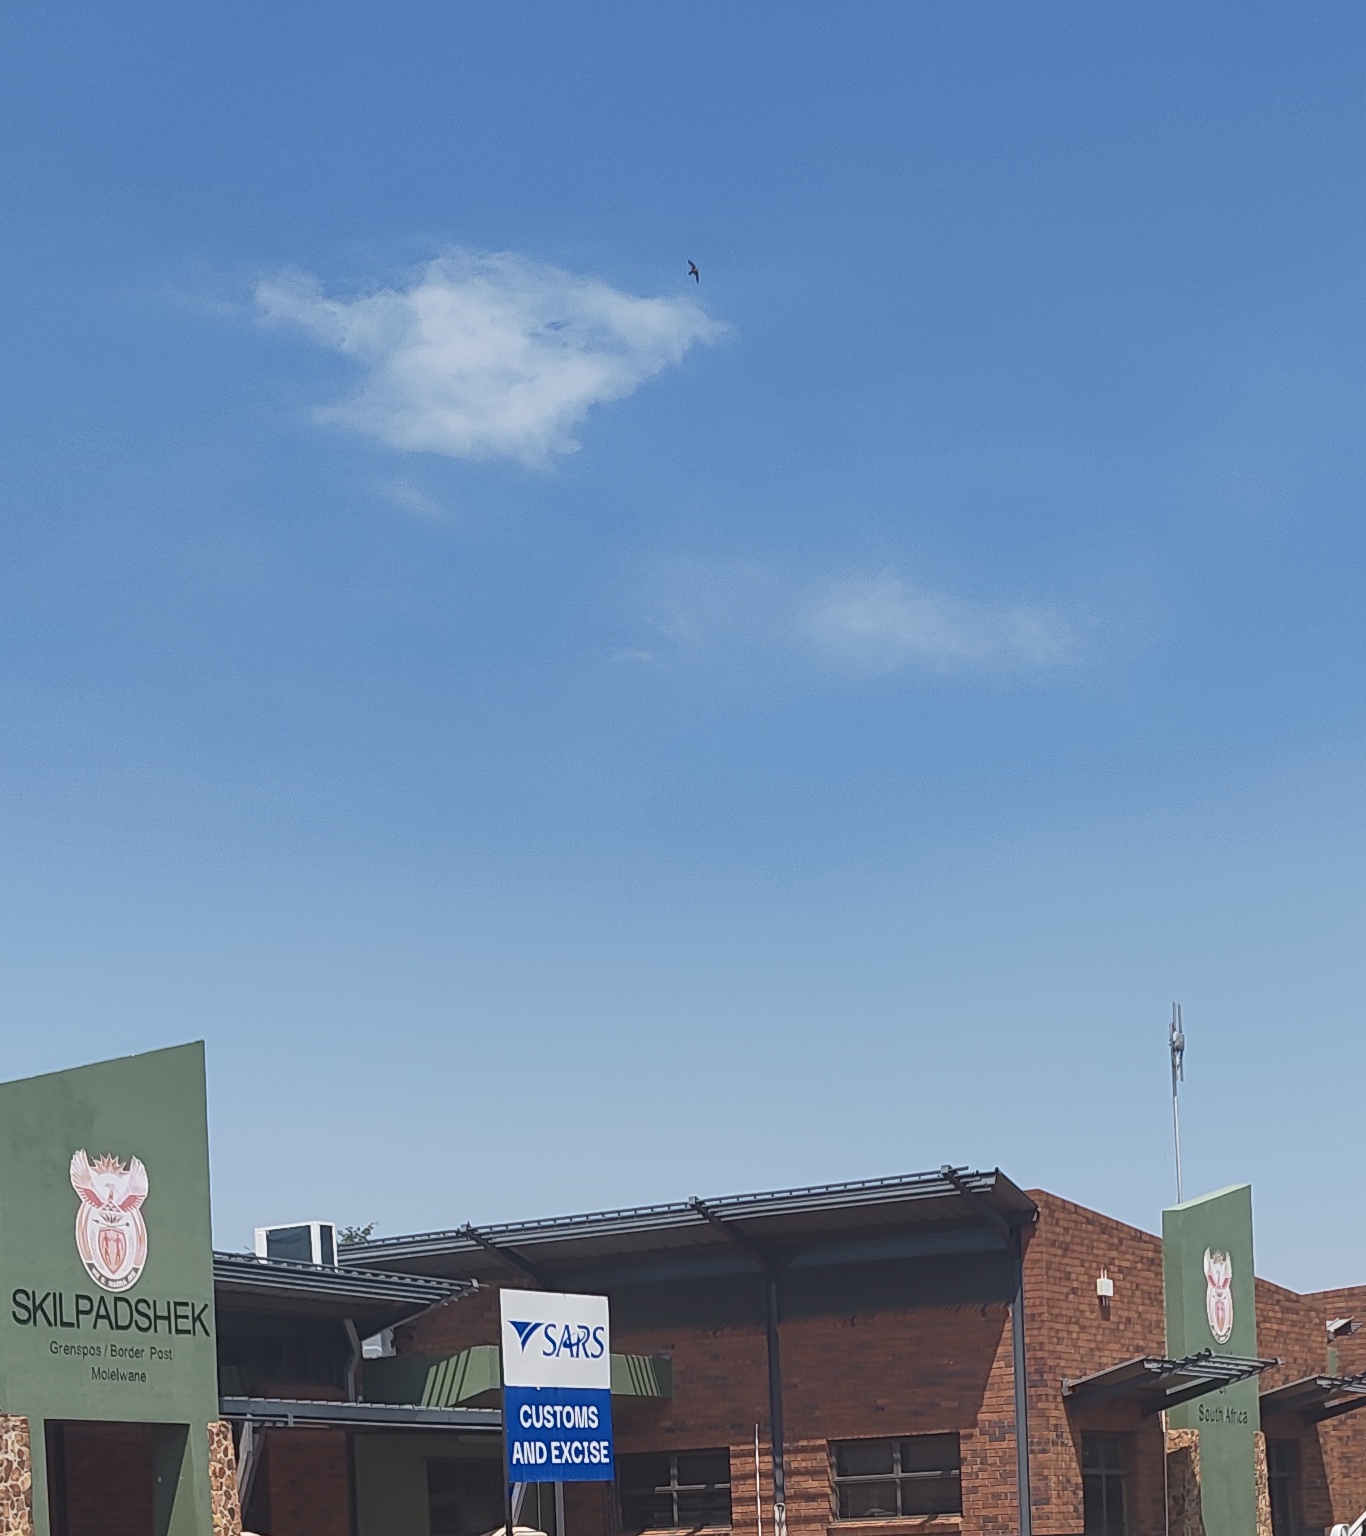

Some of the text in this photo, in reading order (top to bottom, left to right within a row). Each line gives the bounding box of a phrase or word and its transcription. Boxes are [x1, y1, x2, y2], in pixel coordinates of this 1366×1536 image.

[12, 1288, 210, 1337] SKILPADSHEK
[49, 1340, 101, 1360] Grenspos
[110, 1344, 144, 1358] Border
[150, 1346, 173, 1360] Post
[542, 1323, 605, 1359] SARS
[91, 1366, 147, 1382] Molelwane
[519, 1404, 599, 1429] CUSTOMS
[1198, 1403, 1248, 1424] South Africa
[512, 1440, 610, 1465] AND EXCISE
